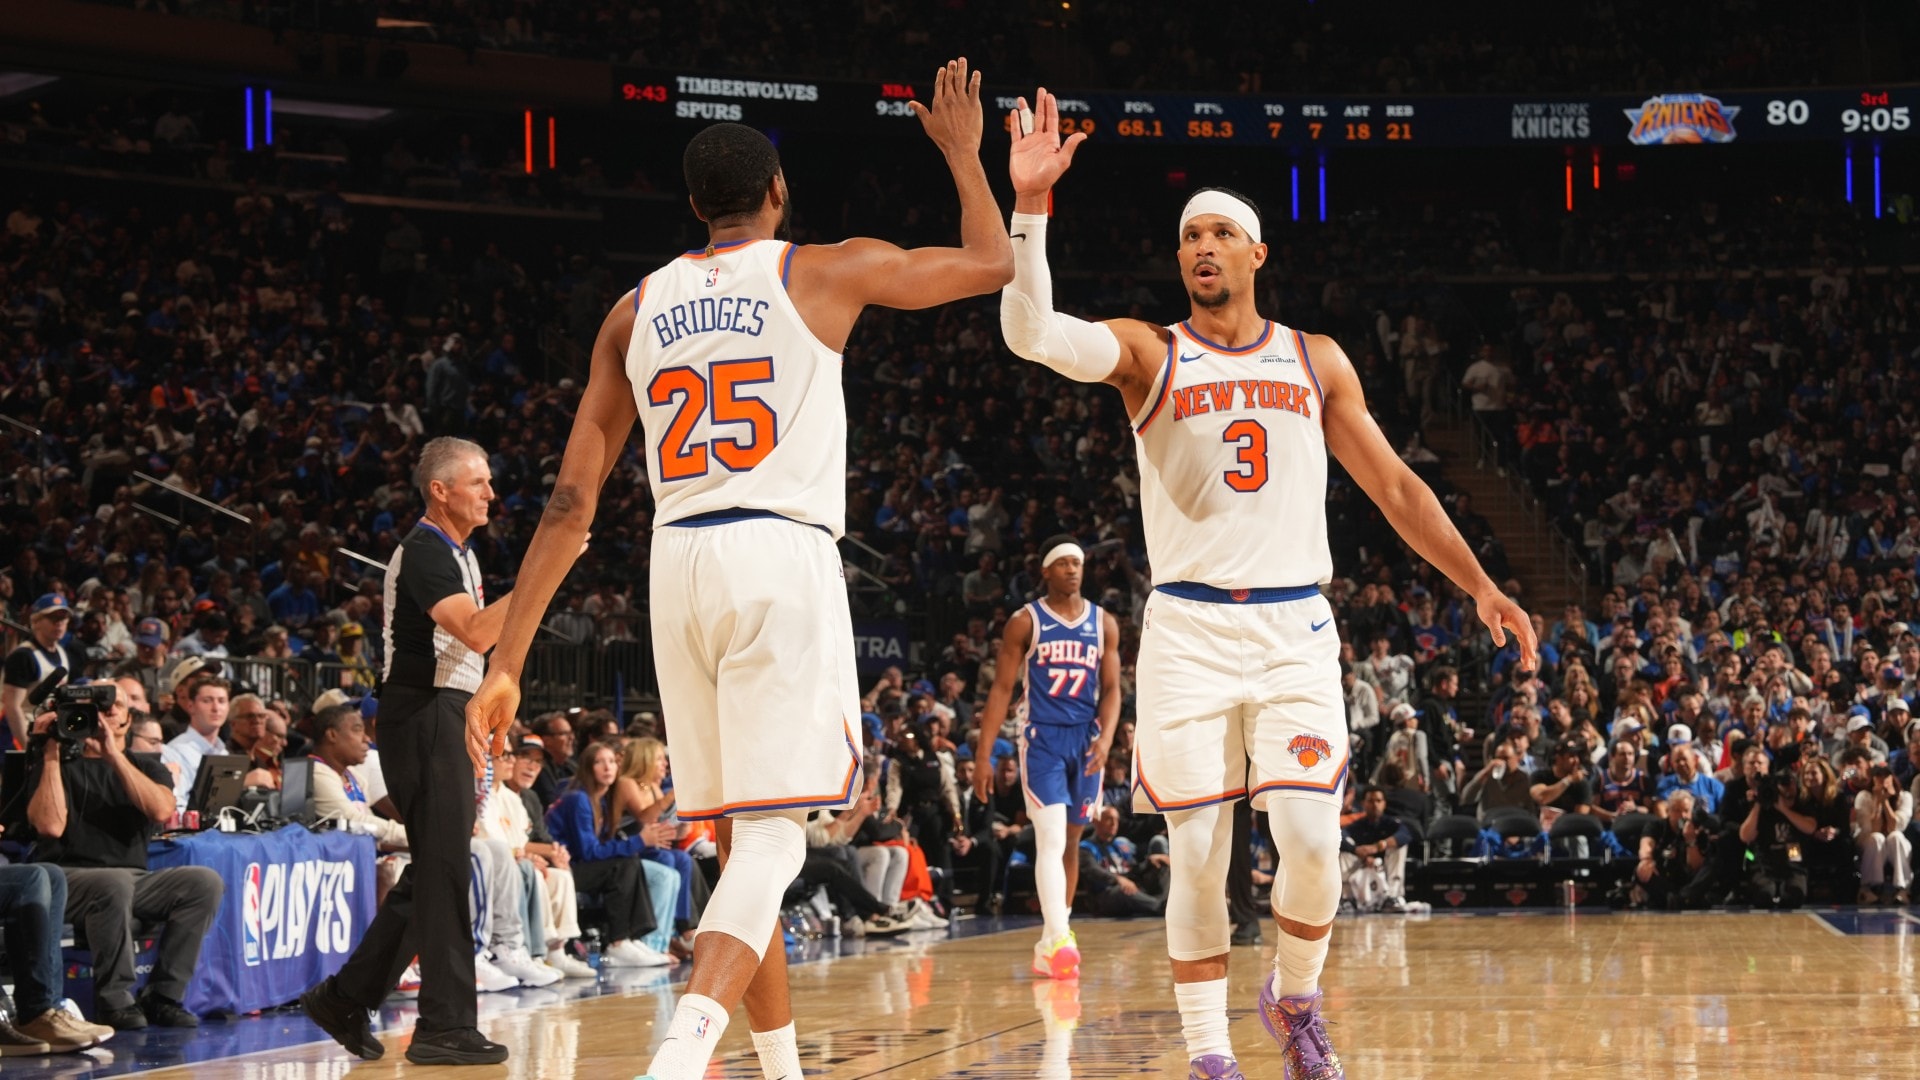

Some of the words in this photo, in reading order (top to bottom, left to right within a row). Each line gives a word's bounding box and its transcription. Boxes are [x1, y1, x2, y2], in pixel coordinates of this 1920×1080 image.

[623, 83, 667, 101] 9:43
[676, 76, 818, 101] TIMBERWOLVES
[882, 83, 915, 98] NBA
[875, 99, 916, 117] 9:30
[1124, 101, 1155, 114] FG%
[1860, 92, 1889, 106] 3rd
[676, 101, 742, 121] SPURS
[1194, 102, 1223, 115] FT%
[1264, 104, 1285, 116] TO
[1302, 105, 1329, 117] STL
[1344, 105, 1371, 117] AST
[1385, 105, 1414, 117] REB
[1511, 104, 1547, 117] NEW
[1549, 103, 1590, 116] YORK
[1766, 99, 1809, 126] 80
[1059, 117, 1096, 135] 2.9
[1118, 119, 1163, 137] 68.1
[1511, 116, 1591, 139] KNICKS
[1634, 99, 1731, 139] KNICKS
[1841, 106, 1911, 132] 9:05
[1187, 120, 1234, 138] 58.3
[1267, 122, 1282, 138] 7
[1308, 123, 1323, 139] 7
[1346, 123, 1371, 140] 18
[1386, 123, 1412, 140] 21
[652, 297, 770, 348] BRIDGES
[1172, 380, 1236, 421] NEW
[1238, 379, 1312, 419] YORK
[646, 356, 779, 483] 25
[1222, 418, 1269, 493] 3
[1036, 639, 1099, 670] PHILA
[1047, 668, 1088, 698] 77
